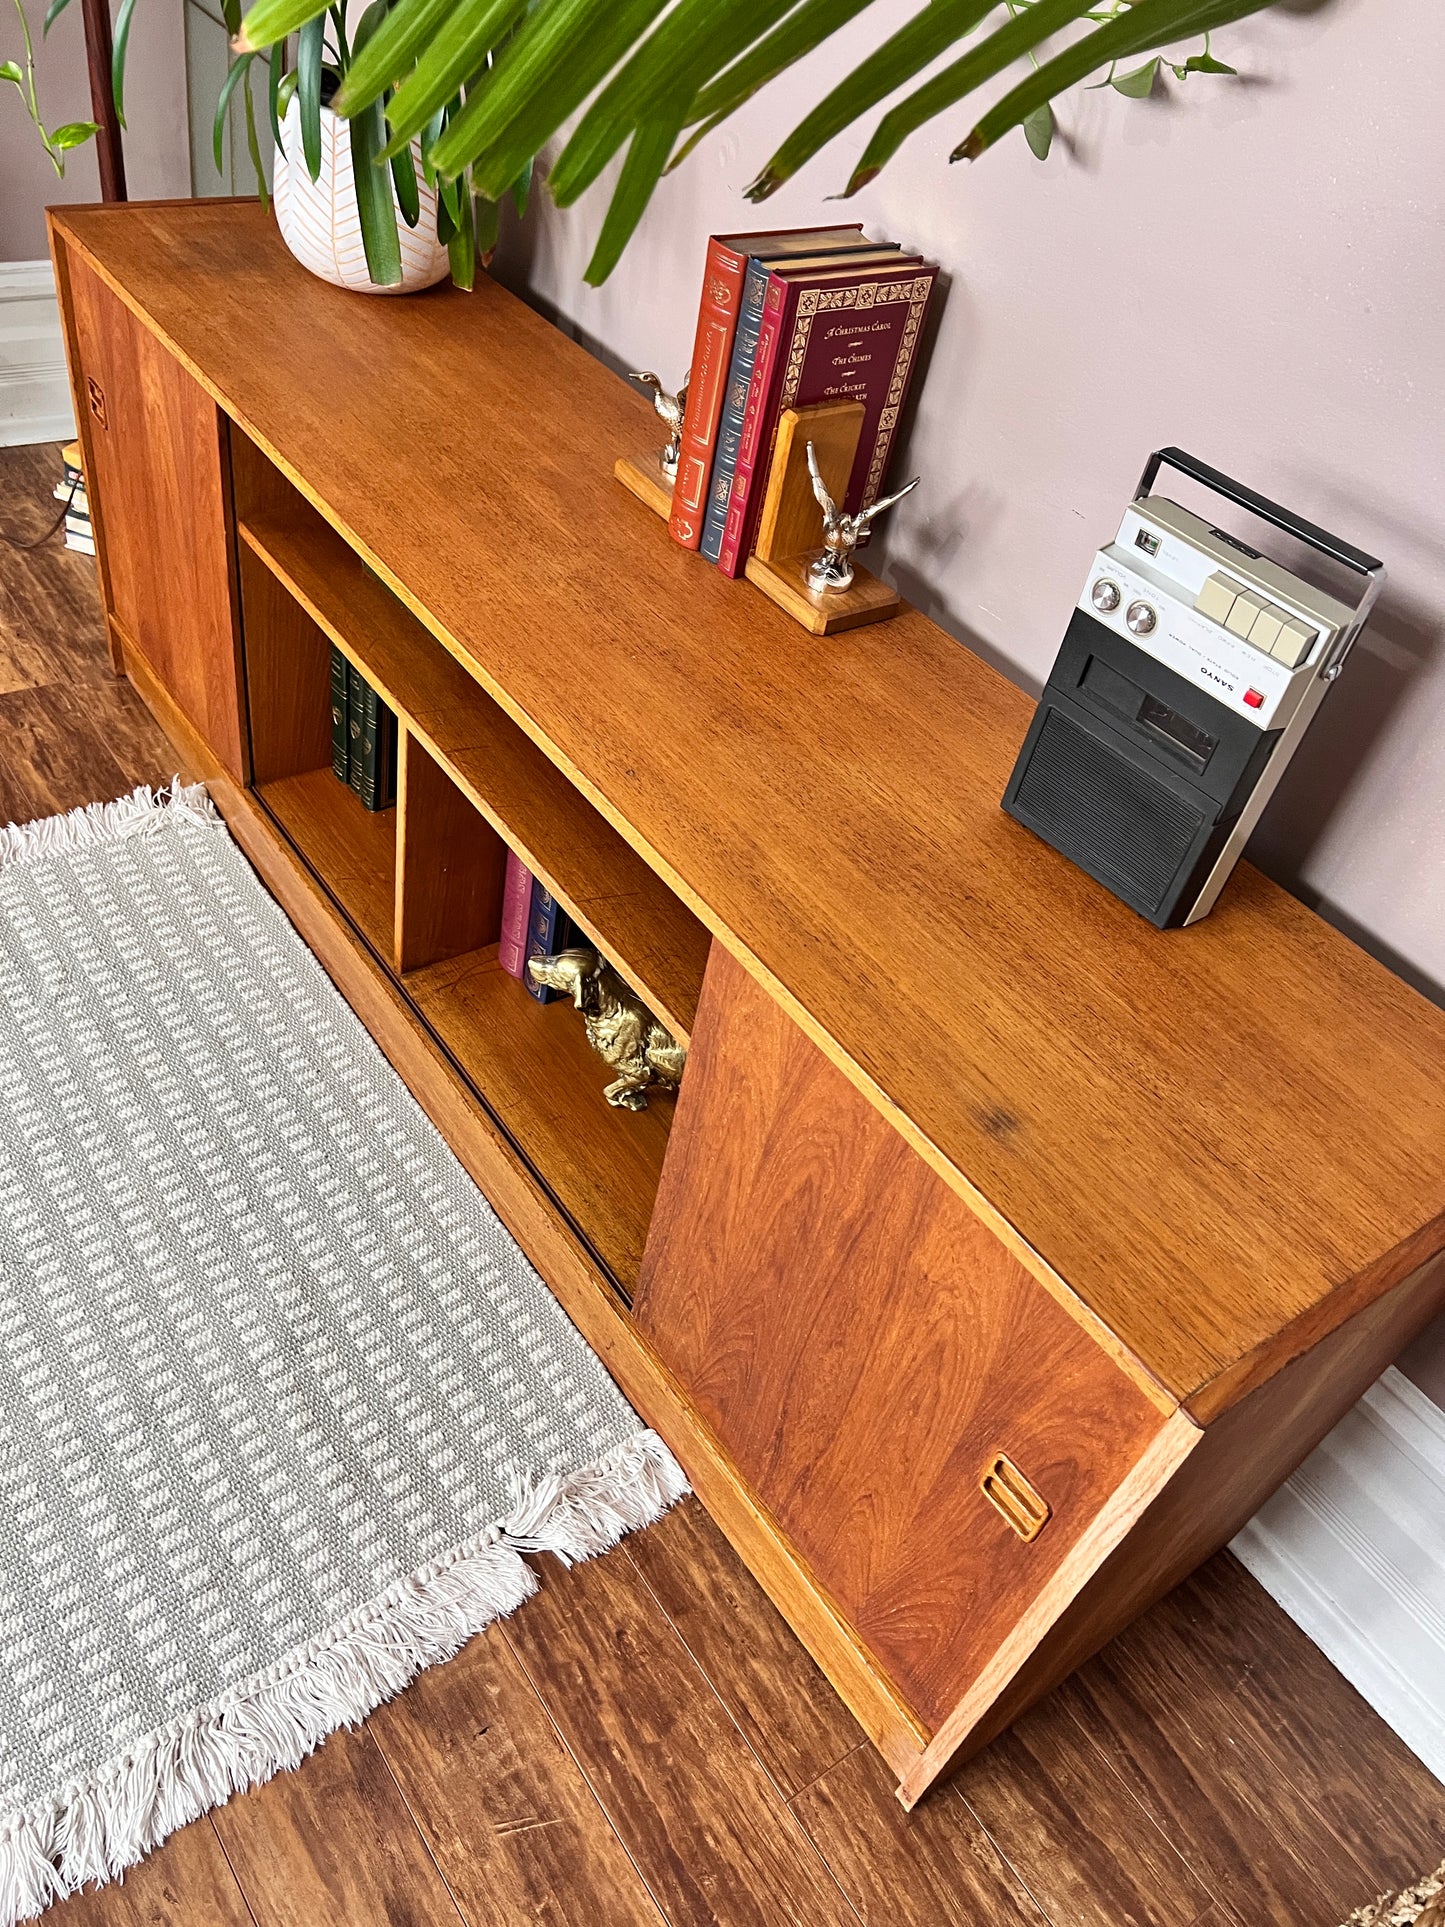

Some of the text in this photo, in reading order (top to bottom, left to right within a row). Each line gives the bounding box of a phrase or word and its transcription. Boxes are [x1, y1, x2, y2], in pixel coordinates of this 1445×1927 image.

[834, 325, 870, 336] CHRISTMAS
[871, 320, 891, 331] CAROL
[831, 353, 871, 365] THE CHIMES
[823, 382, 867, 395] THE CRICKET
[1198, 666, 1234, 691] SANYO
